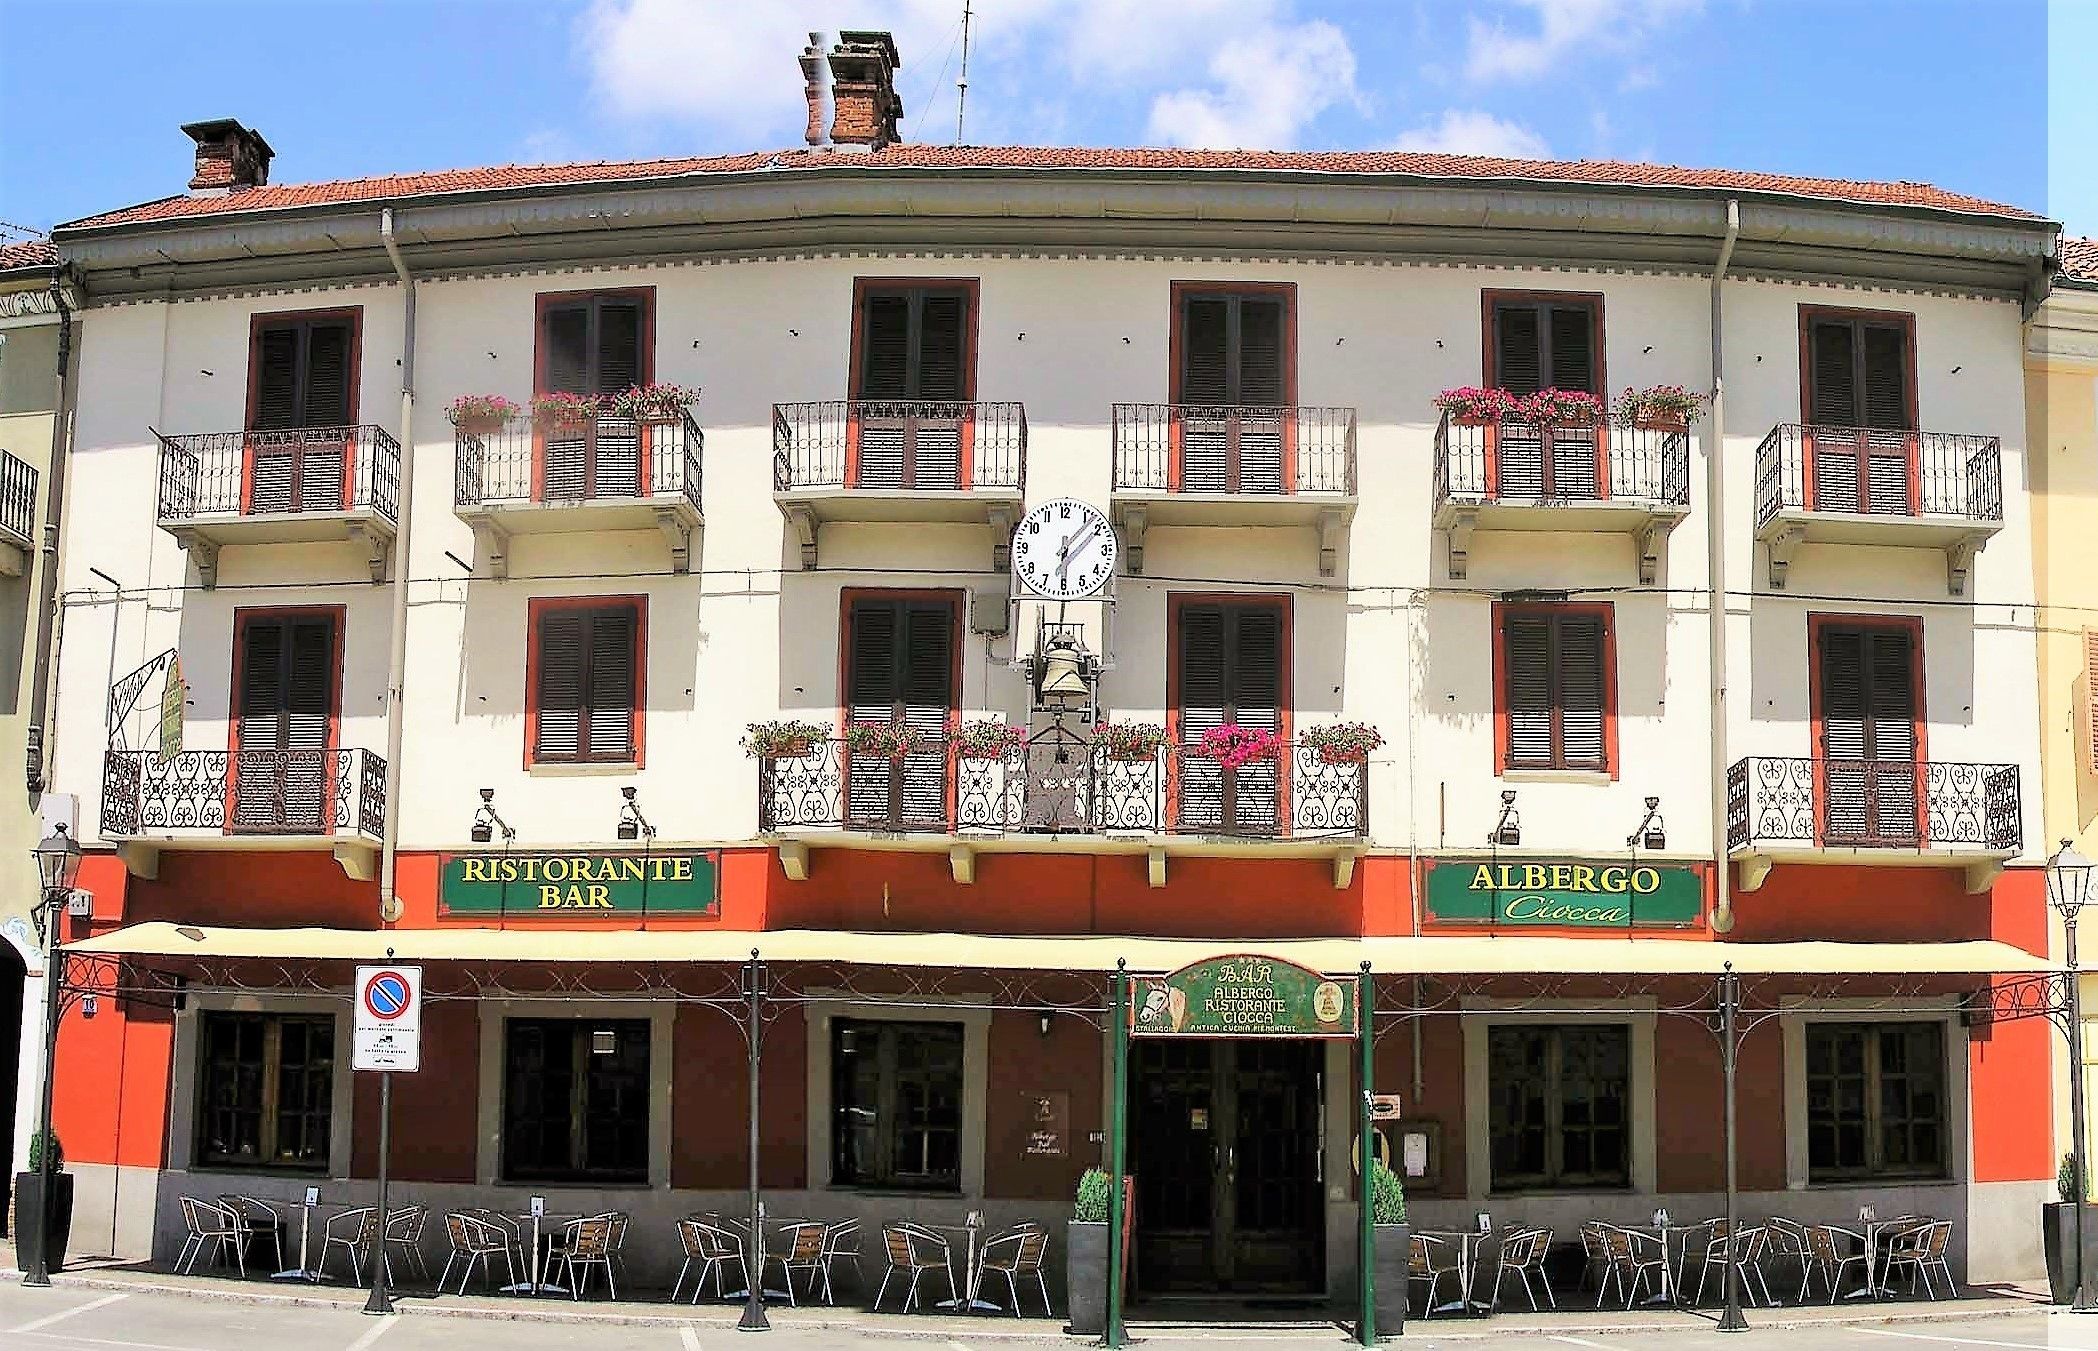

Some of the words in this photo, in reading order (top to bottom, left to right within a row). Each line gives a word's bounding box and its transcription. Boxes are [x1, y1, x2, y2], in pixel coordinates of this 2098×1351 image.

[1043, 510, 1051, 523] 11
[1060, 506, 1071, 519] 12
[1029, 522, 1040, 534] 10
[1093, 524, 1102, 536] 2
[1021, 542, 1029, 554] 9
[1101, 544, 1108, 556] 3
[1028, 562, 1035, 574] 8
[1092, 563, 1099, 575] 4
[1042, 573, 1049, 586] 7
[1060, 578, 1067, 590] 6
[1079, 575, 1086, 587] 5
[461, 857, 694, 882] RISTORANTE
[1468, 863, 1661, 893] ALBERGO
[538, 884, 614, 909] BAR
[1504, 894, 1630, 922] Ciocca
[1217, 964, 1274, 984] BAR
[1213, 987, 1273, 999] ALBERGO
[1204, 999, 1286, 1013] RISTORANTE
[1222, 1011, 1274, 1024] CIOCCA
[1190, 1024, 1220, 1032] ANTICA
